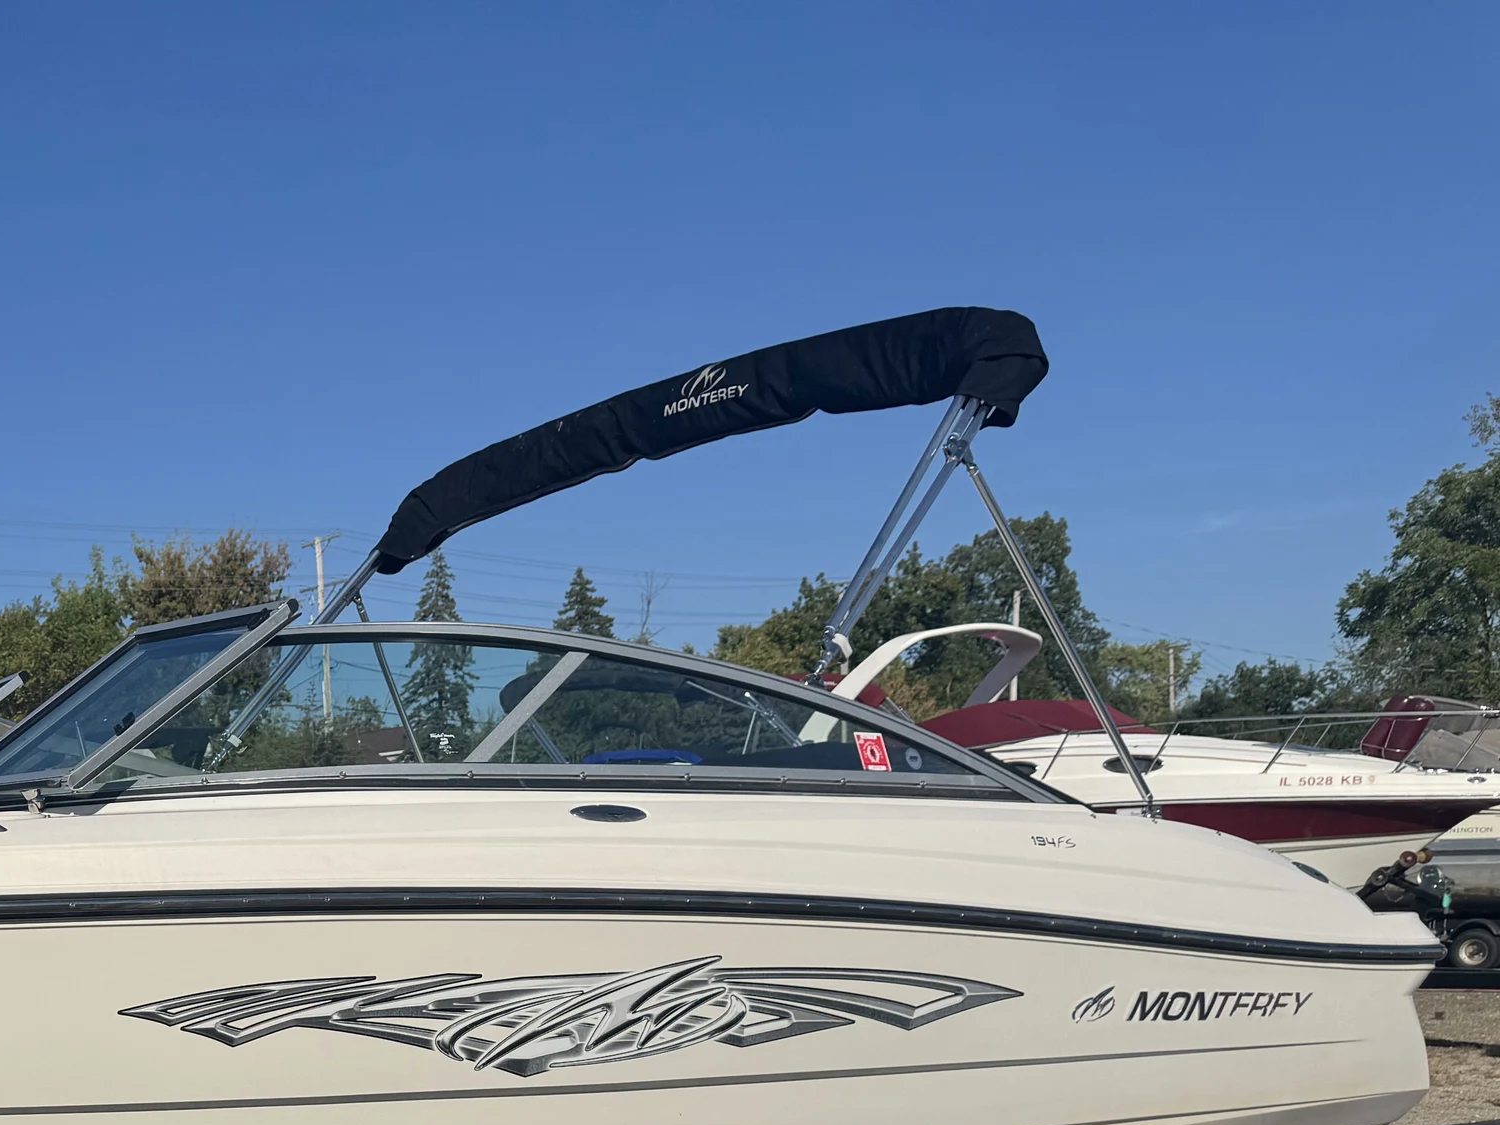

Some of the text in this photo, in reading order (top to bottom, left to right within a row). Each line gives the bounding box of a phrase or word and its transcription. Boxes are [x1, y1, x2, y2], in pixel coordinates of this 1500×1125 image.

[663, 384, 749, 417] MONTEREY
[1279, 774, 1363, 787] IL 5028 KB
[1126, 991, 1313, 1021] MONTEREY
